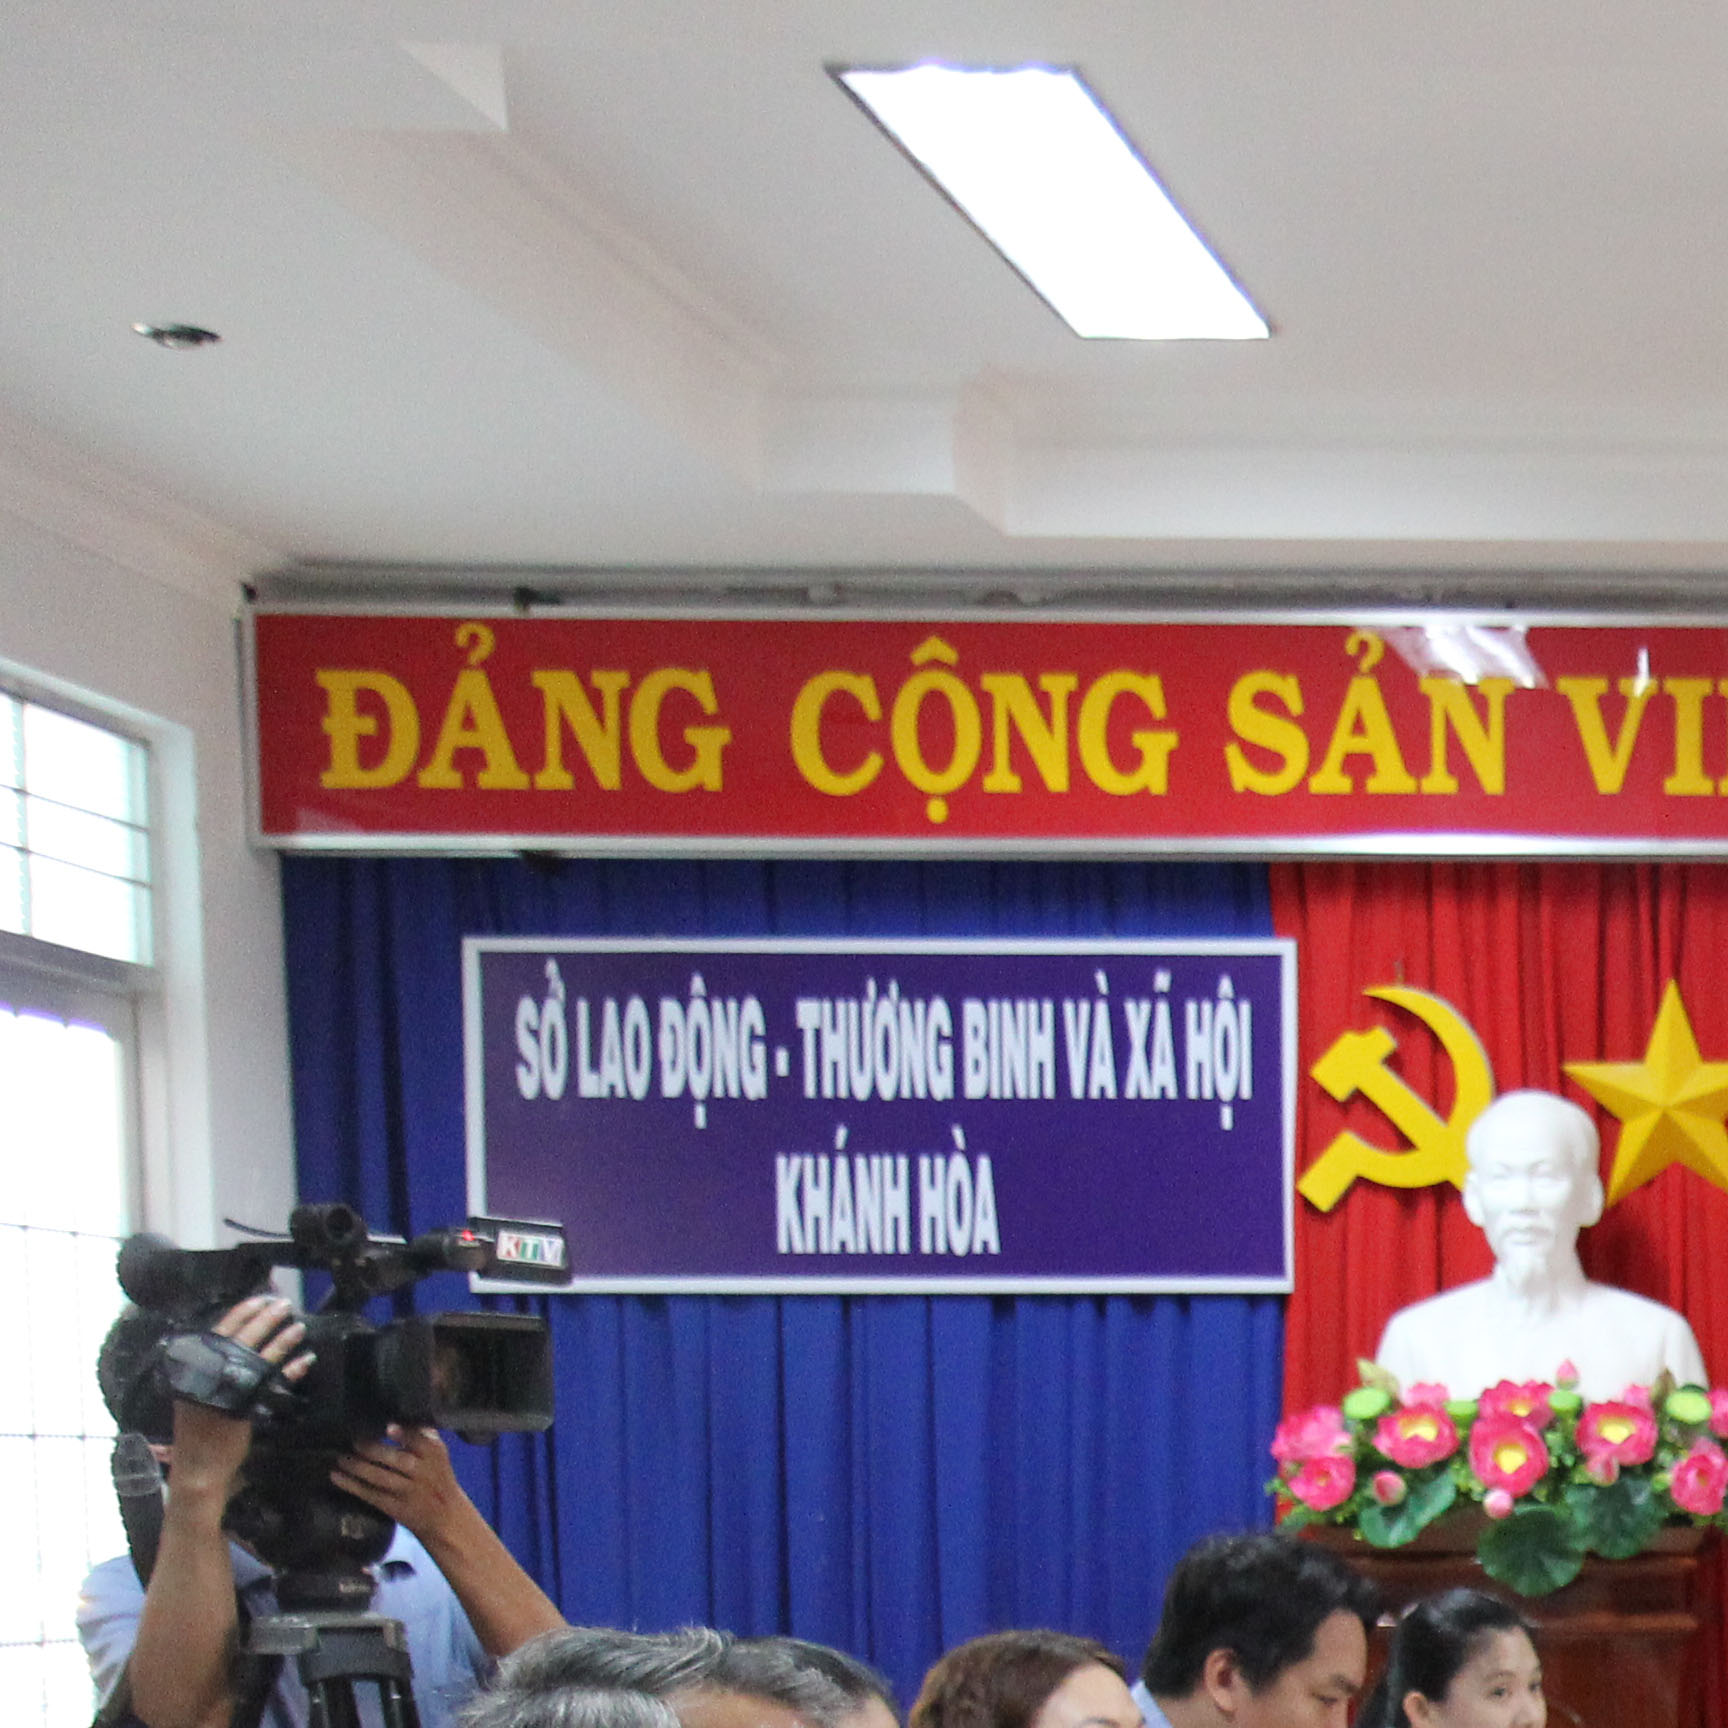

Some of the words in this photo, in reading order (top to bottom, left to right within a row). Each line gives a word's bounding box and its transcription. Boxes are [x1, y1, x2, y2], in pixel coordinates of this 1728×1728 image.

[316, 622, 732, 793] ĐẢNG
[789, 635, 1180, 824] CỘNG
[1223, 630, 1518, 797] SẢN
[515, 960, 568, 1100] SỞ
[576, 997, 652, 1100] LAO
[658, 974, 767, 1129] ĐỘNG
[796, 979, 954, 1101] THƯƠNG
[963, 998, 1055, 1099] BINH
[1063, 970, 1117, 1100] VÀ
[1124, 970, 1178, 1100] XÃ
[1185, 975, 1252, 1131] HỘI
[499, 1233, 563, 1265] KTV
[776, 1125, 910, 1255] KHÁNH
[919, 1125, 1000, 1256] HÒA
